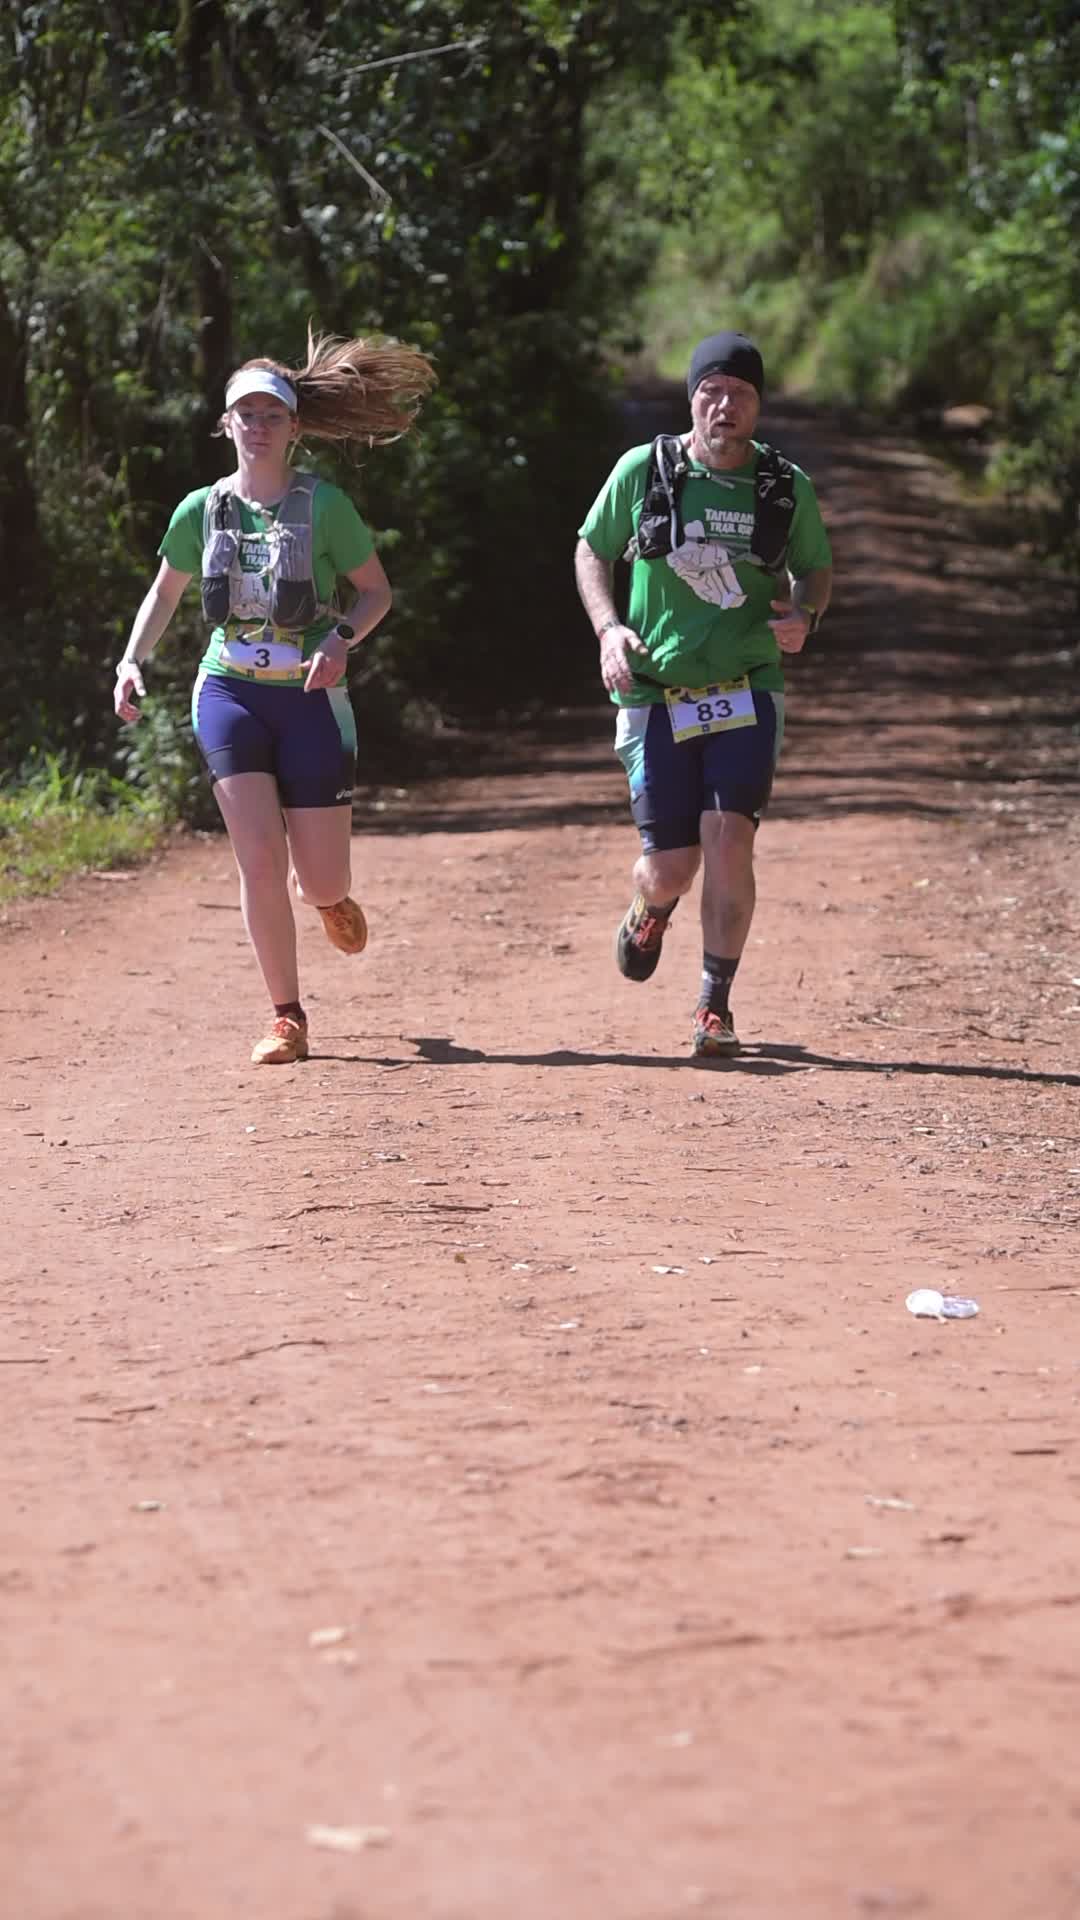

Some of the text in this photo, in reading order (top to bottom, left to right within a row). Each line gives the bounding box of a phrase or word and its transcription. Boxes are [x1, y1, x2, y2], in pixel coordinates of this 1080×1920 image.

[710, 522, 737, 533] TRAIL
[254, 648, 271, 668] 3
[697, 699, 733, 722] 83
